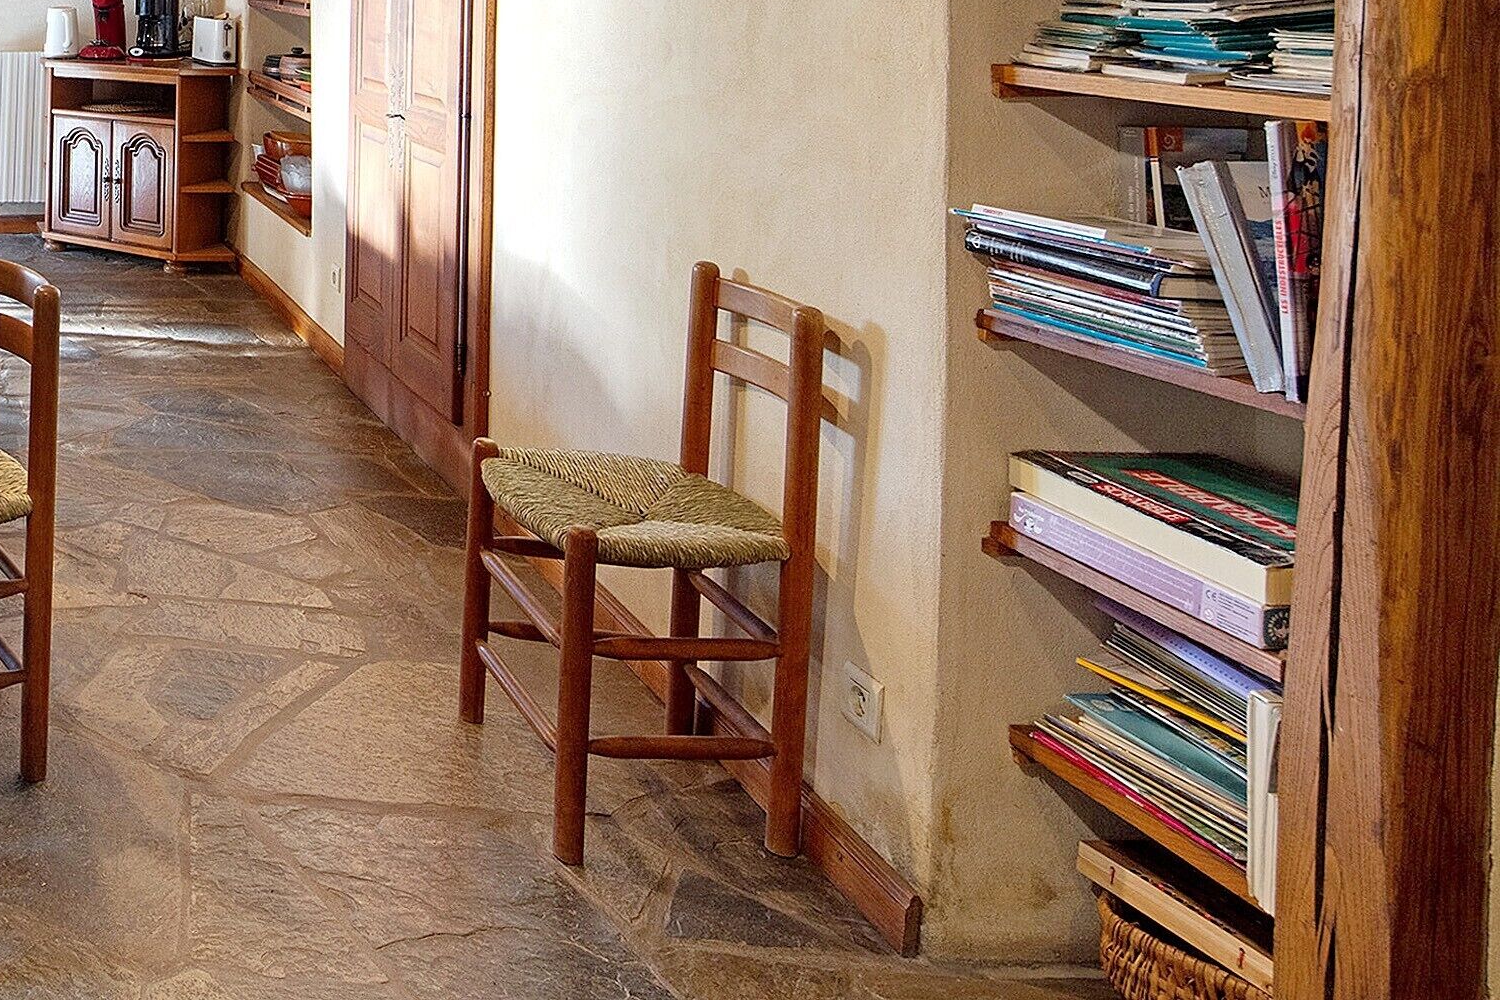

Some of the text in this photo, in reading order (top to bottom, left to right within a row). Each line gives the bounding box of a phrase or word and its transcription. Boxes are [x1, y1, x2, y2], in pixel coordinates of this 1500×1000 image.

[1277, 220, 1290, 314] LES INDESTRUCTIBLES
[1096, 483, 1182, 522] SCRABBLE
